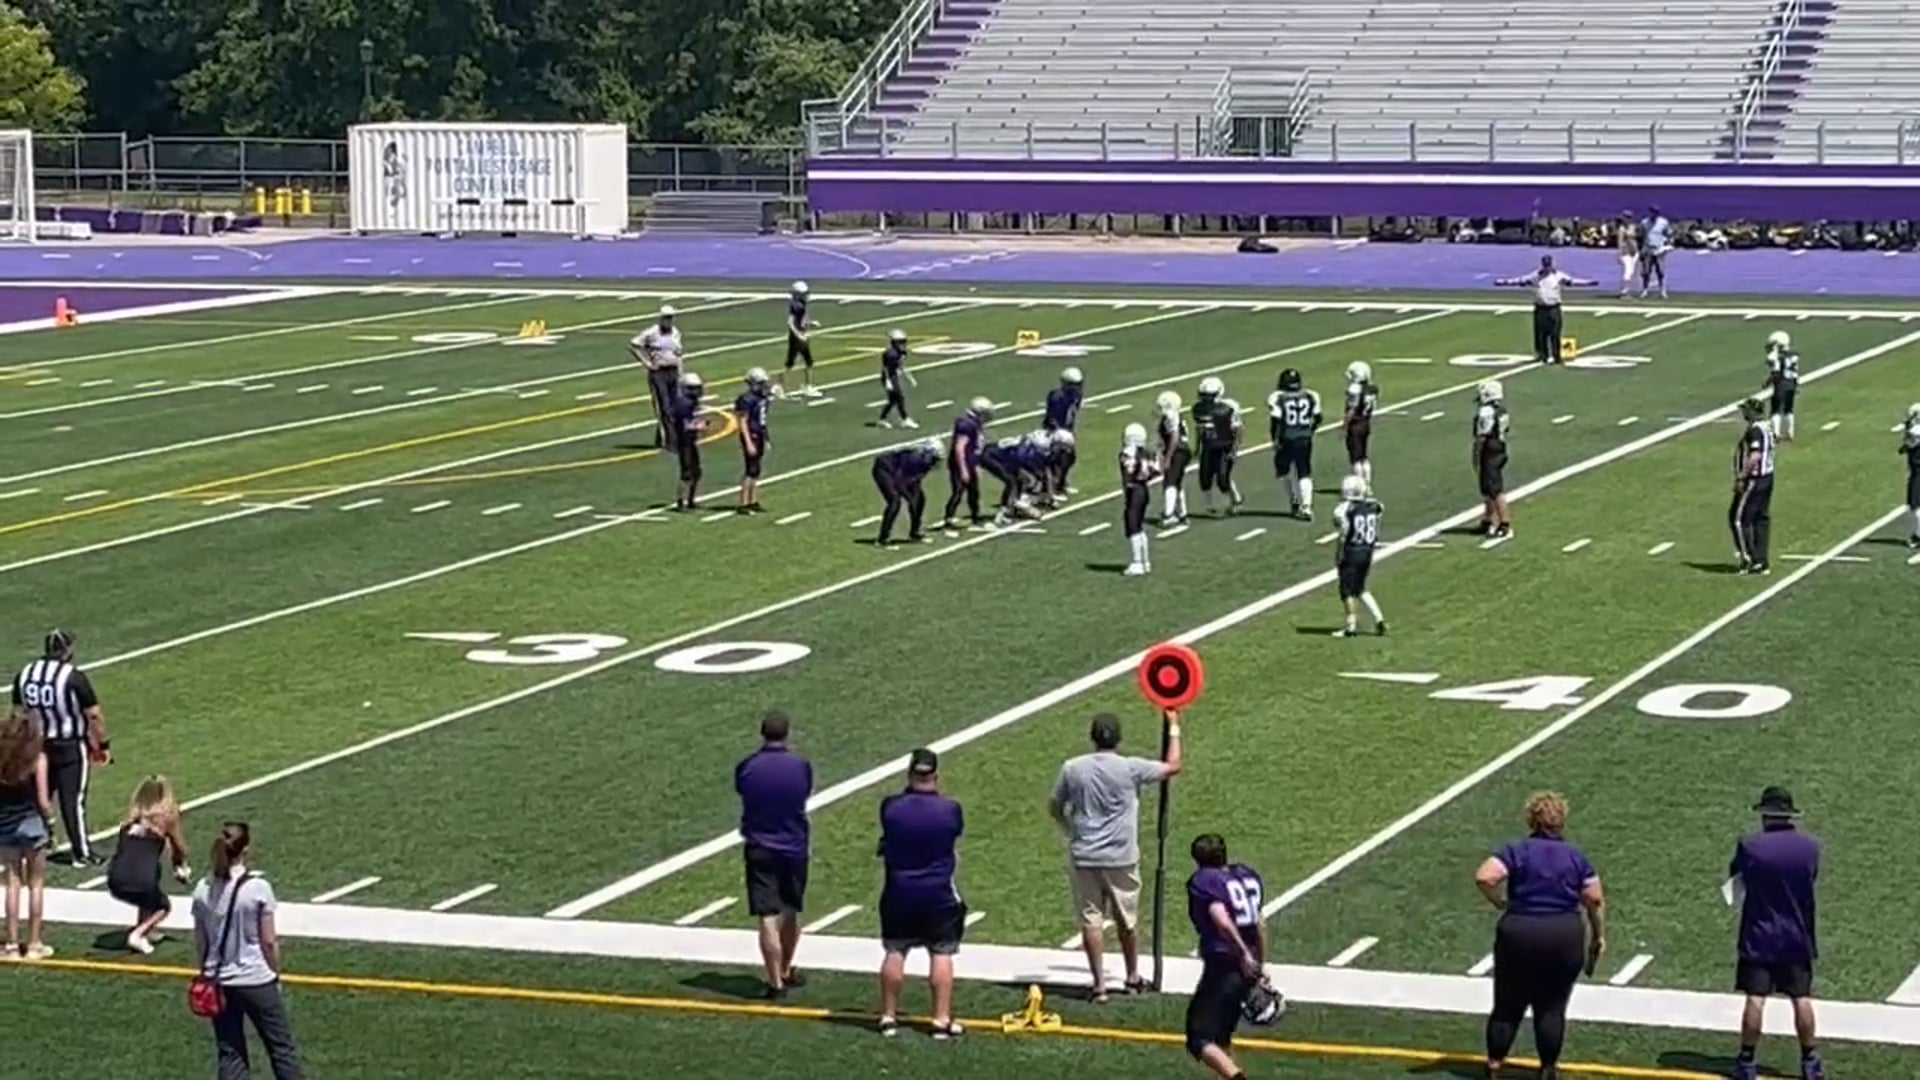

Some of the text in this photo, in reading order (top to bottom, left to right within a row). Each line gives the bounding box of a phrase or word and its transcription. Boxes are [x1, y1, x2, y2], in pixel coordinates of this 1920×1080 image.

[1284, 398, 1310, 425] 62
[1352, 514, 1378, 544] 88
[25, 683, 54, 707] 90
